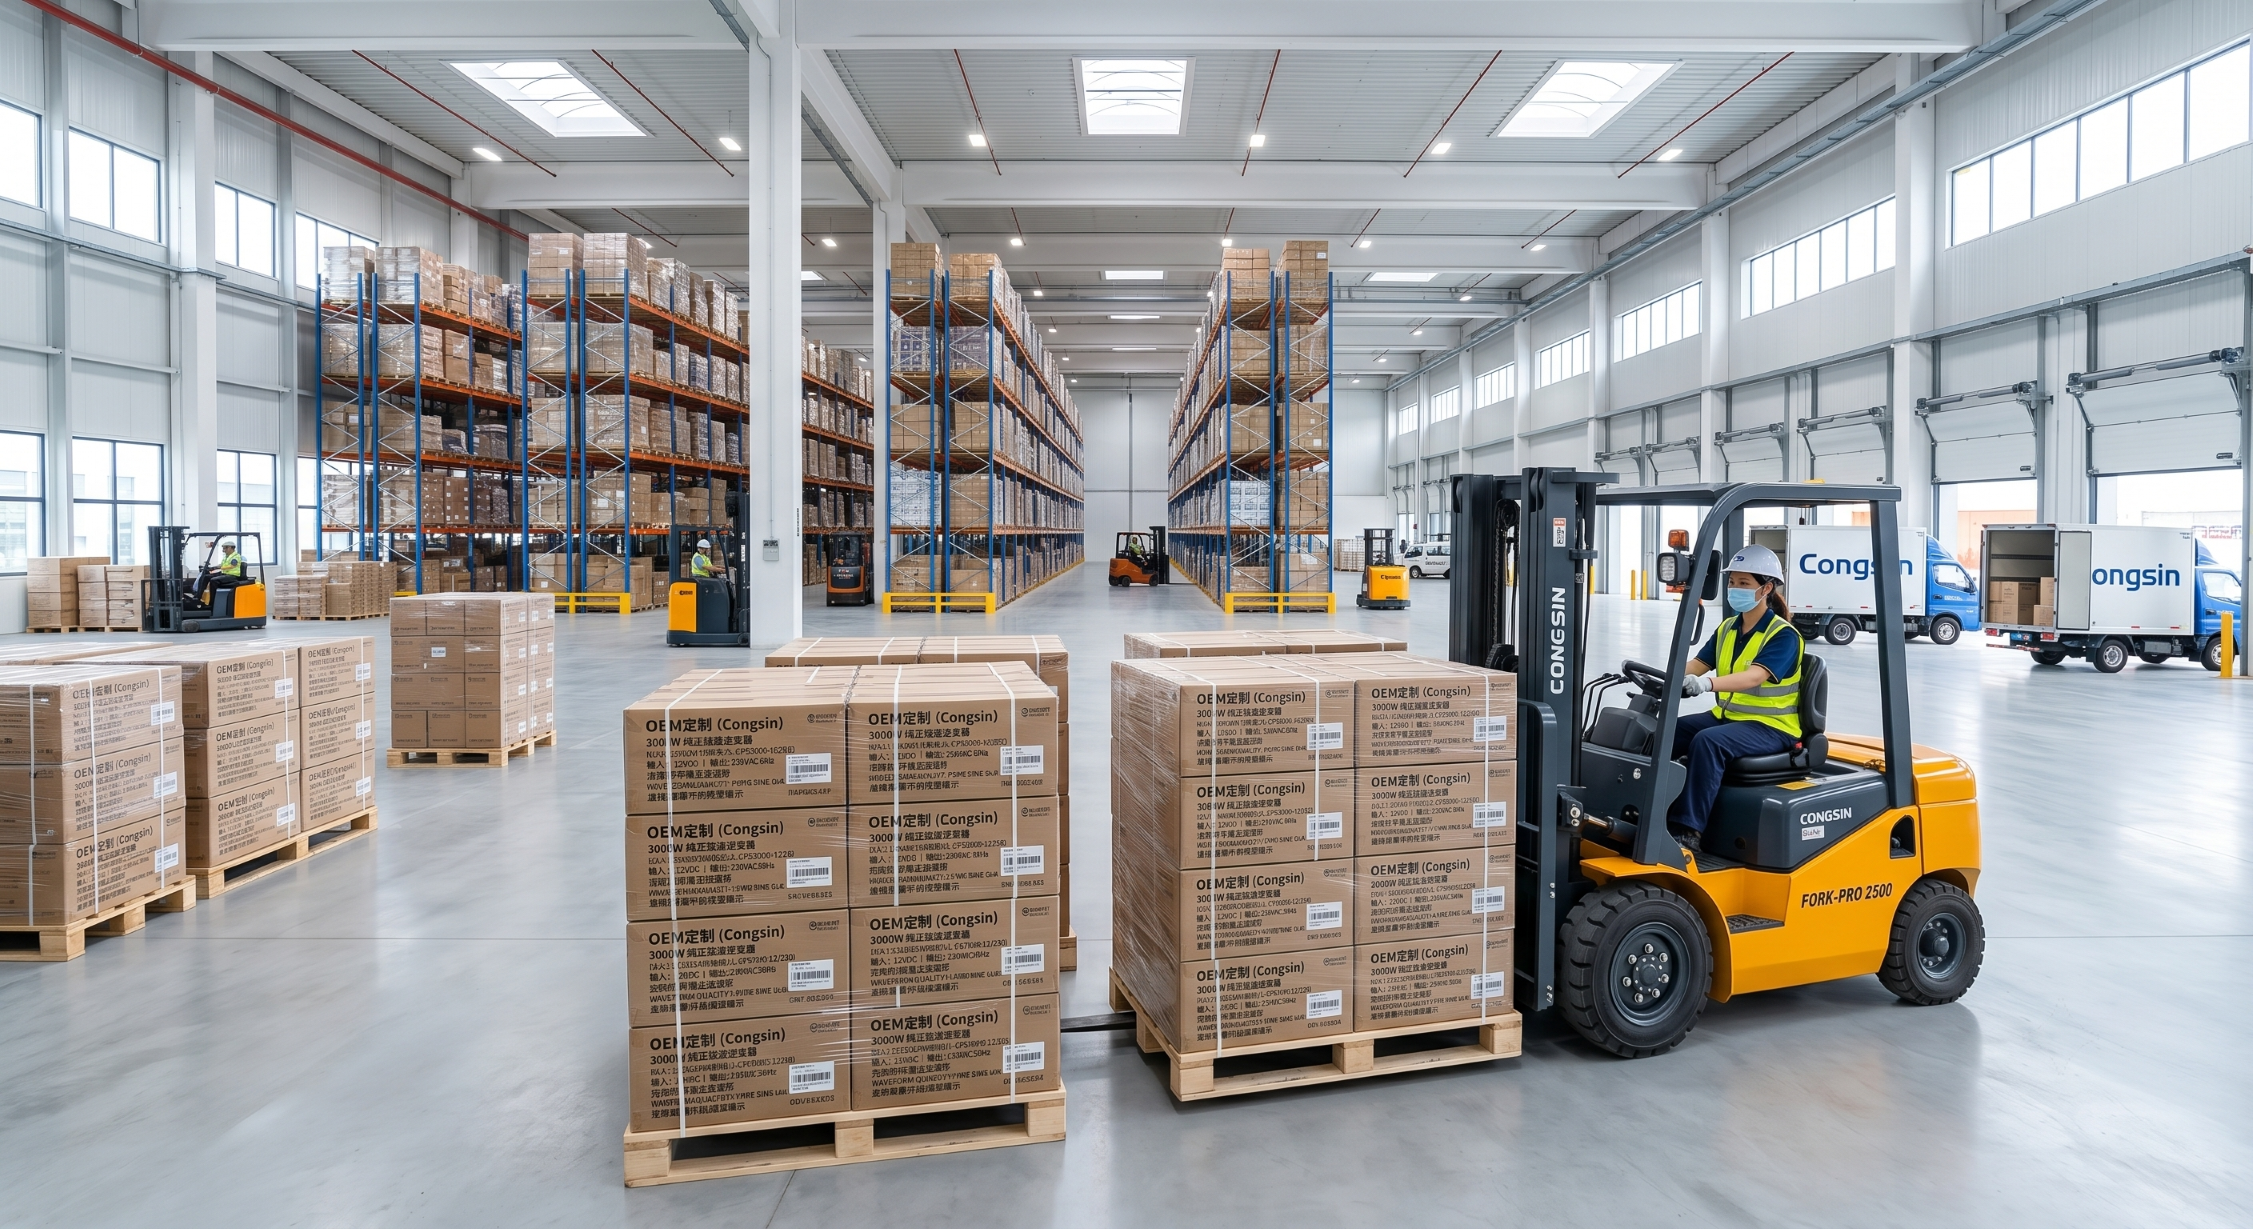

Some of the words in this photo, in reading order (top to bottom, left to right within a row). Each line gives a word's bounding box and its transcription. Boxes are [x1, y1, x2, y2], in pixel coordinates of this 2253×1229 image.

[1800, 554, 1913, 580] Congn
[2092, 564, 2180, 591] ongsin
[1550, 587, 1566, 695] CONGSIN
[1254, 691, 1306, 705] (Congsin)
[1423, 686, 1471, 698] (Congsin)
[1372, 703, 1398, 711] 3000W
[646, 718, 712, 732] OEM定制
[717, 716, 783, 732] (Congsin)
[935, 710, 998, 726] (Congsin)
[1423, 772, 1470, 786] (Congsin)
[1253, 782, 1305, 796] (Congsin)
[1372, 791, 1397, 799] 3000W
[935, 811, 998, 828] (Congsin)
[1800, 807, 1852, 825] CONGSIN
[647, 823, 713, 839] OEM定制
[718, 821, 784, 839] (Congsin)
[1422, 859, 1469, 874] (Congsin)
[1253, 872, 1305, 888] (Congsin)
[1801, 886, 1862, 908] FORK-PRO
[1865, 883, 1892, 899] 2500
[869, 914, 931, 931] OEM定制
[936, 911, 998, 928] (Congsin)
[649, 928, 715, 945] OEM定制
[719, 925, 785, 942] (Congsin)
[870, 934, 904, 945] 3000W
[649, 949, 685, 960] 3000W
[1421, 944, 1468, 960] (Congsin)
[1253, 962, 1305, 978] (Congsin)
[1371, 967, 1397, 976] 3000W
[870, 1014, 932, 1031] OEM定制
[937, 1010, 998, 1028] (Congsin)
[650, 1033, 715, 1050] OEM定制
[720, 1027, 786, 1047] (Congsin)
[871, 1035, 905, 1045] 3000W
